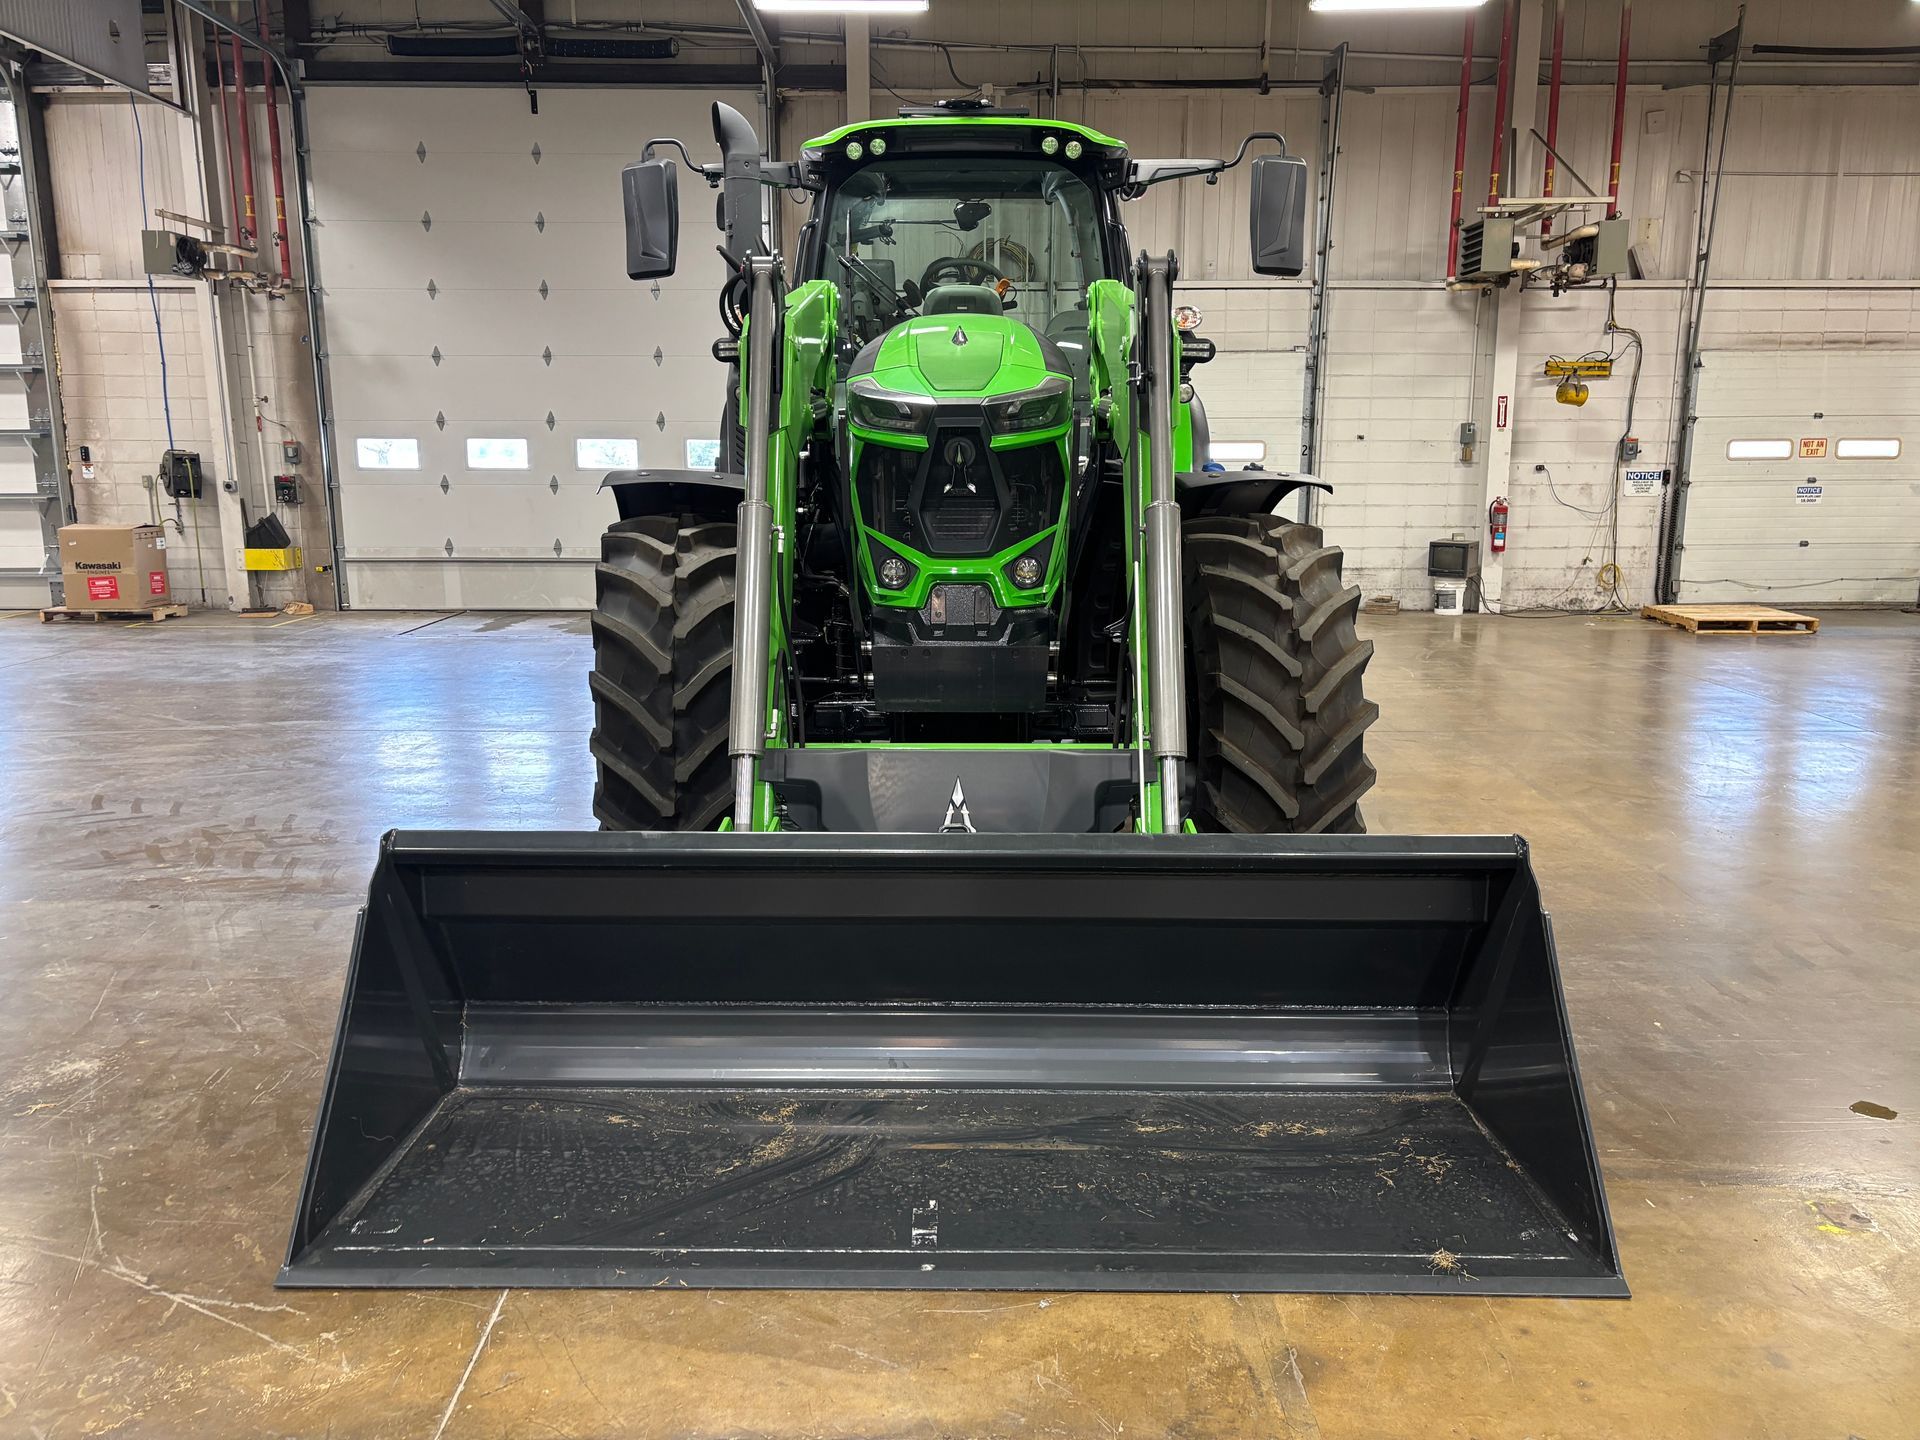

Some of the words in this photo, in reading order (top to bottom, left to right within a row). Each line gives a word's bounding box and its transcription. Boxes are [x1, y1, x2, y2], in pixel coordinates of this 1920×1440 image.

[1301, 444, 1308, 456] 2
[1627, 472, 1660, 480] NOTICE
[75, 561, 121, 570] Kawasaki
